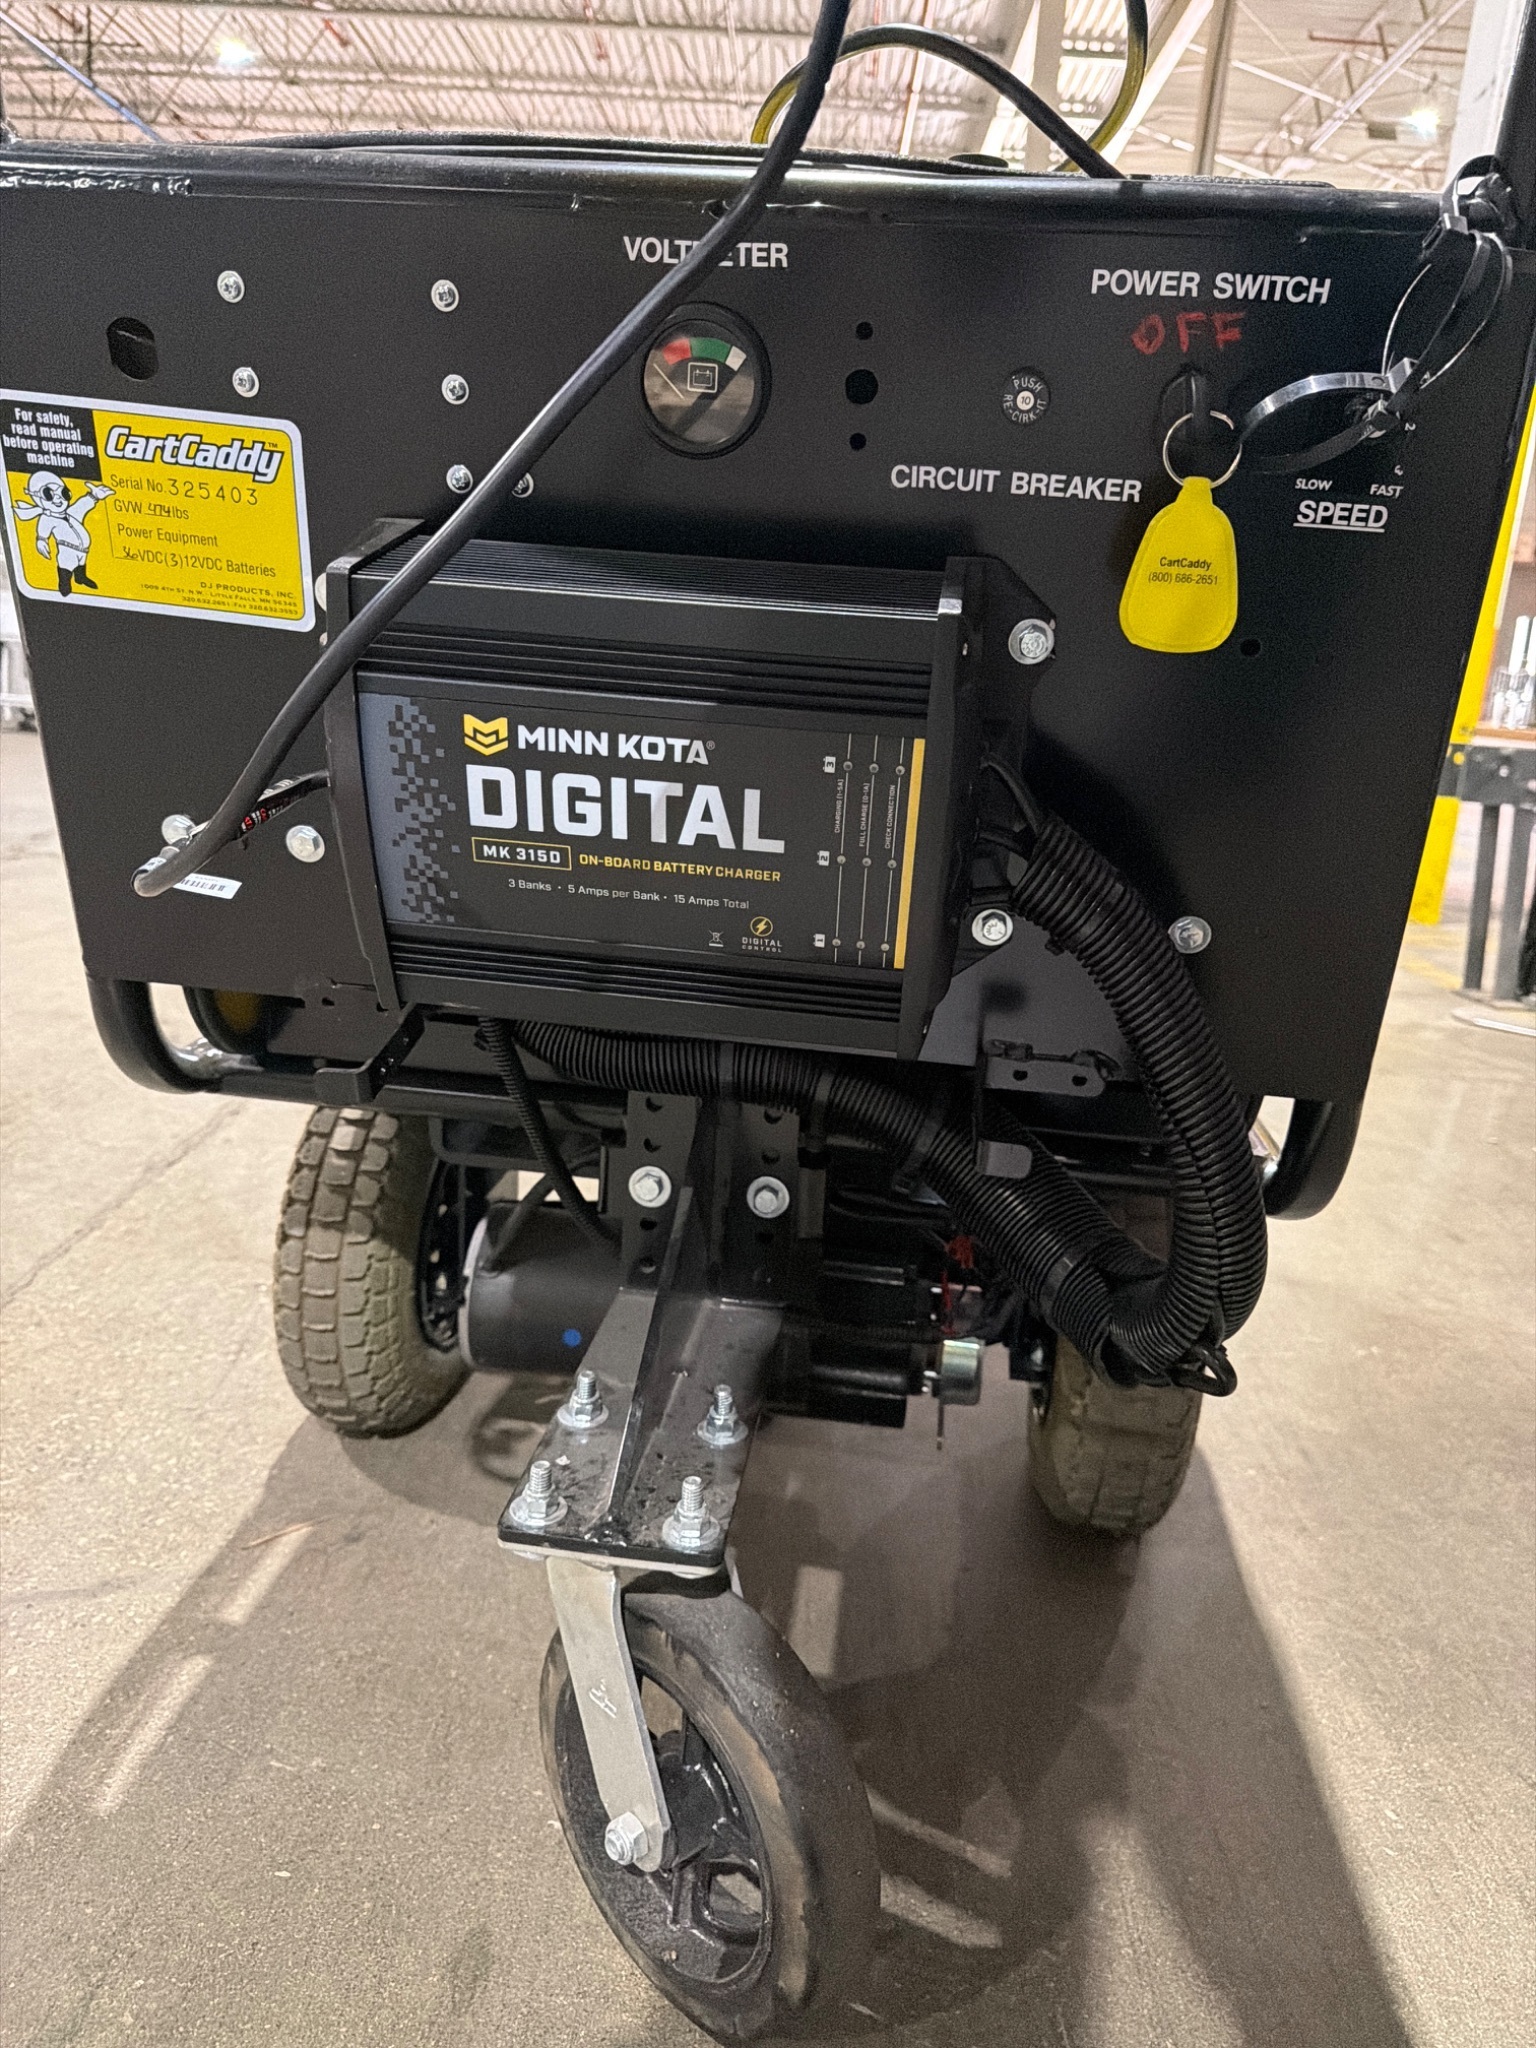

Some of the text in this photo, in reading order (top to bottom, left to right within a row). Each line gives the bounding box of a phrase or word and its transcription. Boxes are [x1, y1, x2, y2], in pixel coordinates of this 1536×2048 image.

[623, 235, 788, 268] VOLTTER
[1091, 268, 1331, 304] POWER SWITCH
[1130, 311, 1247, 355] OFF
[1013, 377, 1043, 393] PUSH
[1021, 396, 1031, 406] 10
[14, 407, 74, 428] For safety,
[11, 423, 82, 441] read manual
[2, 433, 95, 458] before operating
[26, 452, 75, 468] machine
[110, 474, 143, 491] Serial
[890, 464, 1142, 502] CIRCUIT BREAKER
[1294, 478, 1404, 499] SLOW FAST
[114, 499, 142, 514] GVW
[1296, 499, 1389, 528] SPEED
[117, 523, 219, 547] Power Equipment
[226, 559, 277, 578] Batteries
[1159, 556, 1211, 571] CartCaddy
[200, 581, 213, 590] DJ
[1148, 571, 1218, 586] (800) 686-2651
[517, 724, 609, 757] MINN
[826, 760, 835, 769] 3
[465, 763, 785, 854] DIGITAL
[834, 800, 843, 833] CHARGING
[860, 804, 868, 830] CHARGE
[884, 785, 896, 849] CHECK CONNECTION
[482, 844, 561, 864] MK 315D
[578, 853, 781, 882] ON-BOARD BATTERY CHARGER
[508, 878, 750, 909] 3 Banks 5 Amps per Bank 15 Amps Total
[741, 936, 783, 948] DIGITAL
